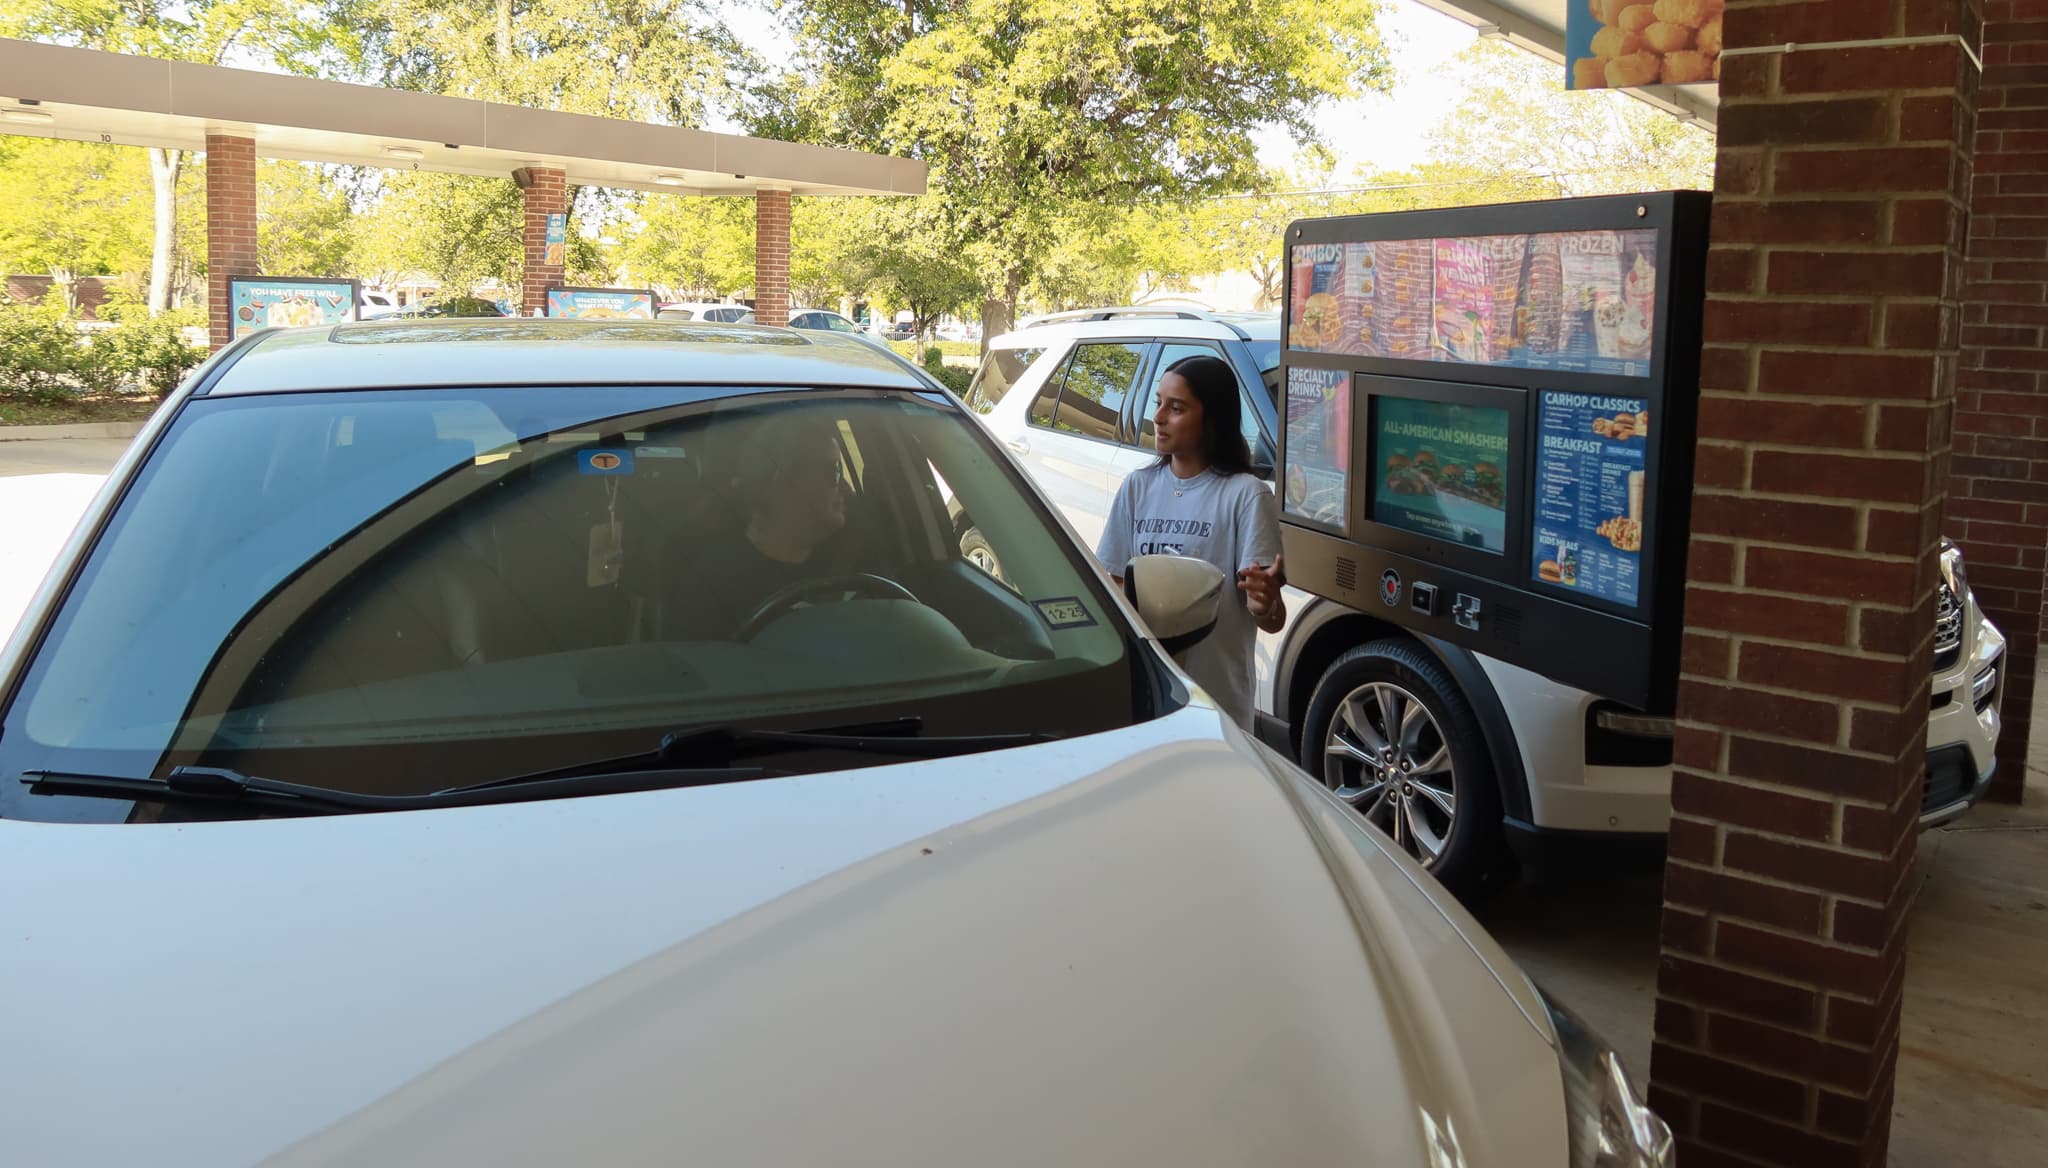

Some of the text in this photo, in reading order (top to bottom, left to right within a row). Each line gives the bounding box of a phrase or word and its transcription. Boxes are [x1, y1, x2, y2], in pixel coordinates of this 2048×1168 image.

[100, 134, 112, 143] 10
[1561, 235, 1624, 254] FROZEN
[250, 287, 337, 298] YOU HAVE FREE WILL
[1288, 367, 1335, 385] SPECIALTY
[1288, 382, 1322, 398] DRINKS
[1545, 393, 1641, 413] CARHOP CLASSICS
[1384, 420, 1452, 443] ALL-AMERICAN
[1544, 435, 1603, 454] BREAKFAST
[1539, 535, 1556, 546] KIDS
